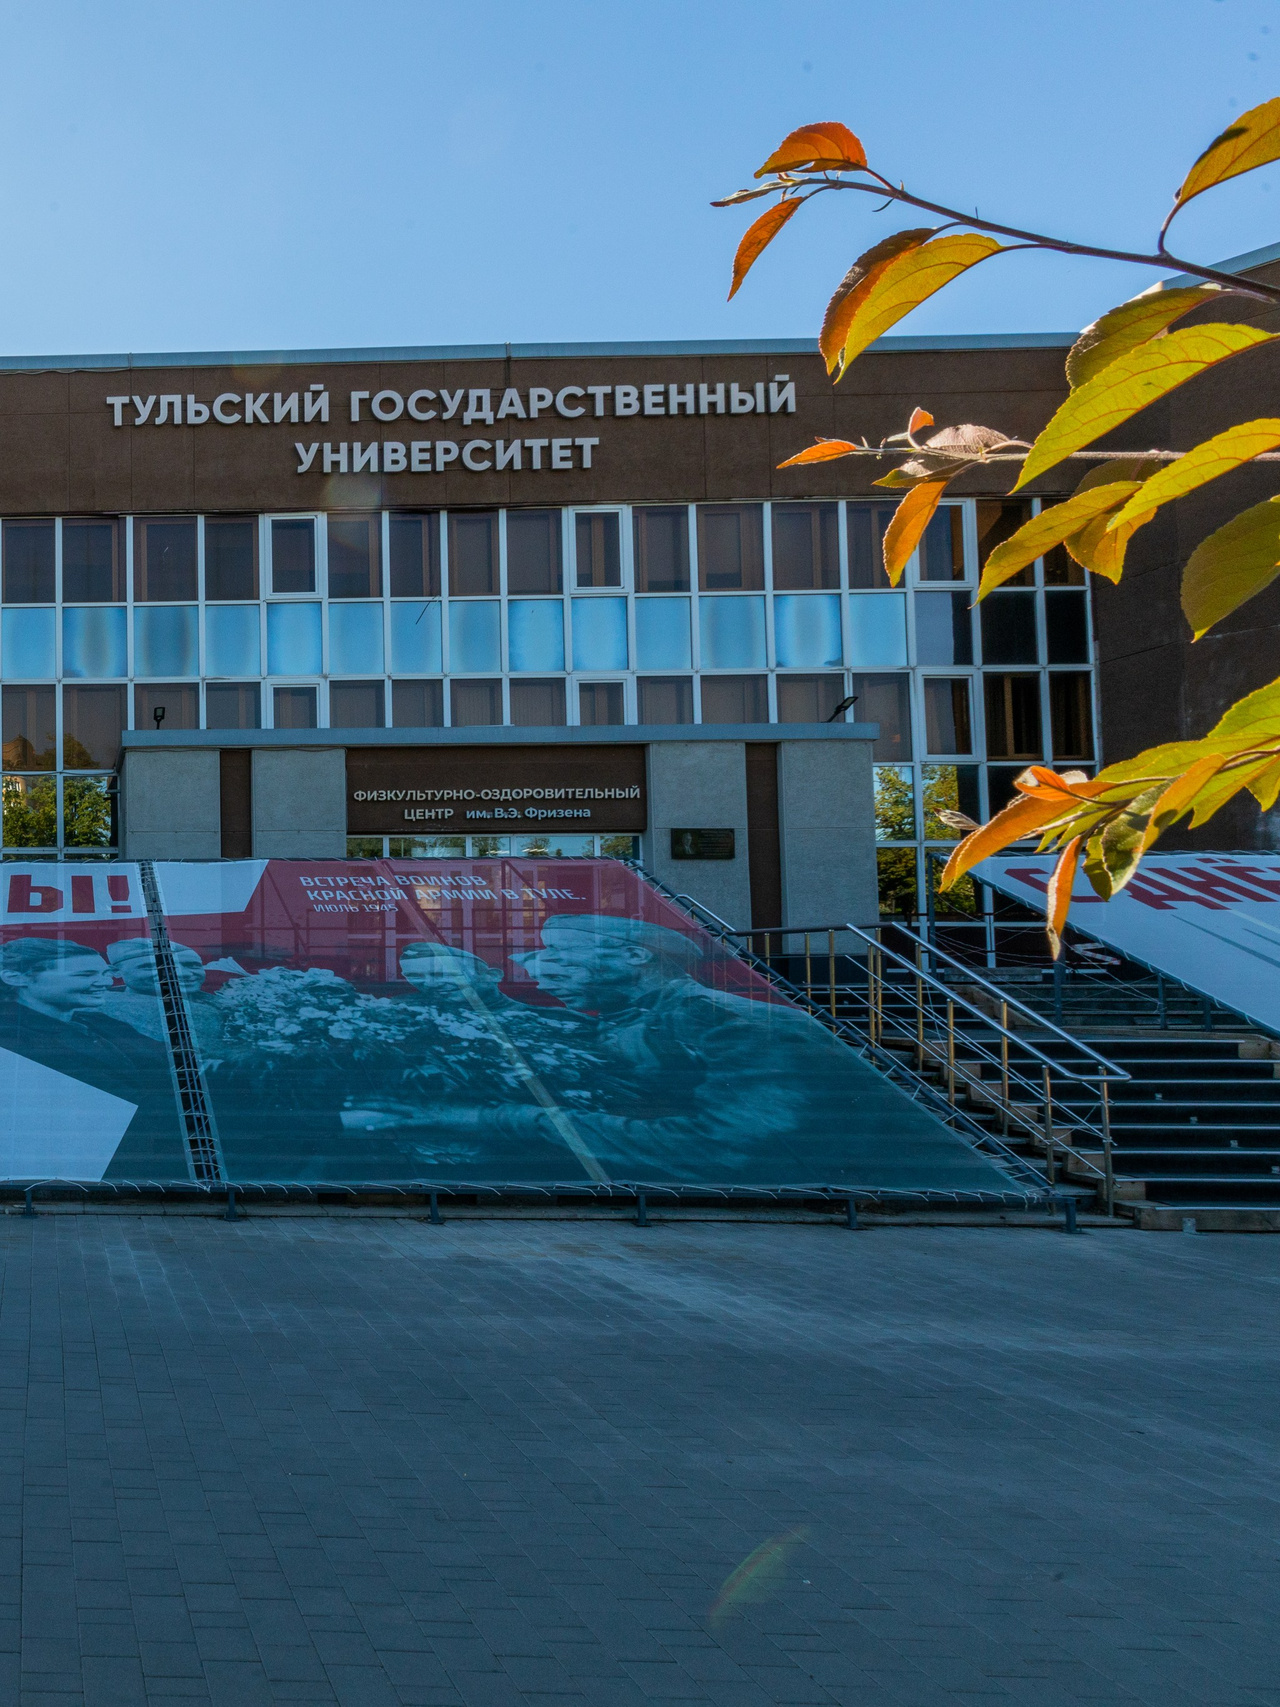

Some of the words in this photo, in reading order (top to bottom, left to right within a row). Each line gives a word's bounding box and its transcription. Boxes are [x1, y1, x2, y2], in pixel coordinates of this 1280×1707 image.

[106, 384, 330, 426] ТУЛЬСКИЙ
[350, 374, 797, 425] ГОСУДАРСТВЕННЫЙ
[295, 437, 599, 473] УНИВЕРСИТЕТ
[354, 786, 640, 802] ФИЗКУЛЬТУРНО-ОЗДОРОВИТЕЛЬНЫЙ
[404, 808, 454, 821] ЦЕНТР
[466, 809, 491, 819] им.
[524, 807, 591, 820] Фризена
[299, 876, 391, 887] ВСТРЕЧА
[394, 875, 487, 886] ВОИНОВ
[1122, 858, 1280, 910] ДНЁ
[307, 887, 408, 901] КРАСНОЙ
[415, 889, 498, 900] АРМИИ
[501, 889, 519, 900] В
[521, 888, 586, 900] ТУЛЕ.
[313, 904, 360, 912] ИЮЛЬ
[361, 904, 399, 912] 1945
